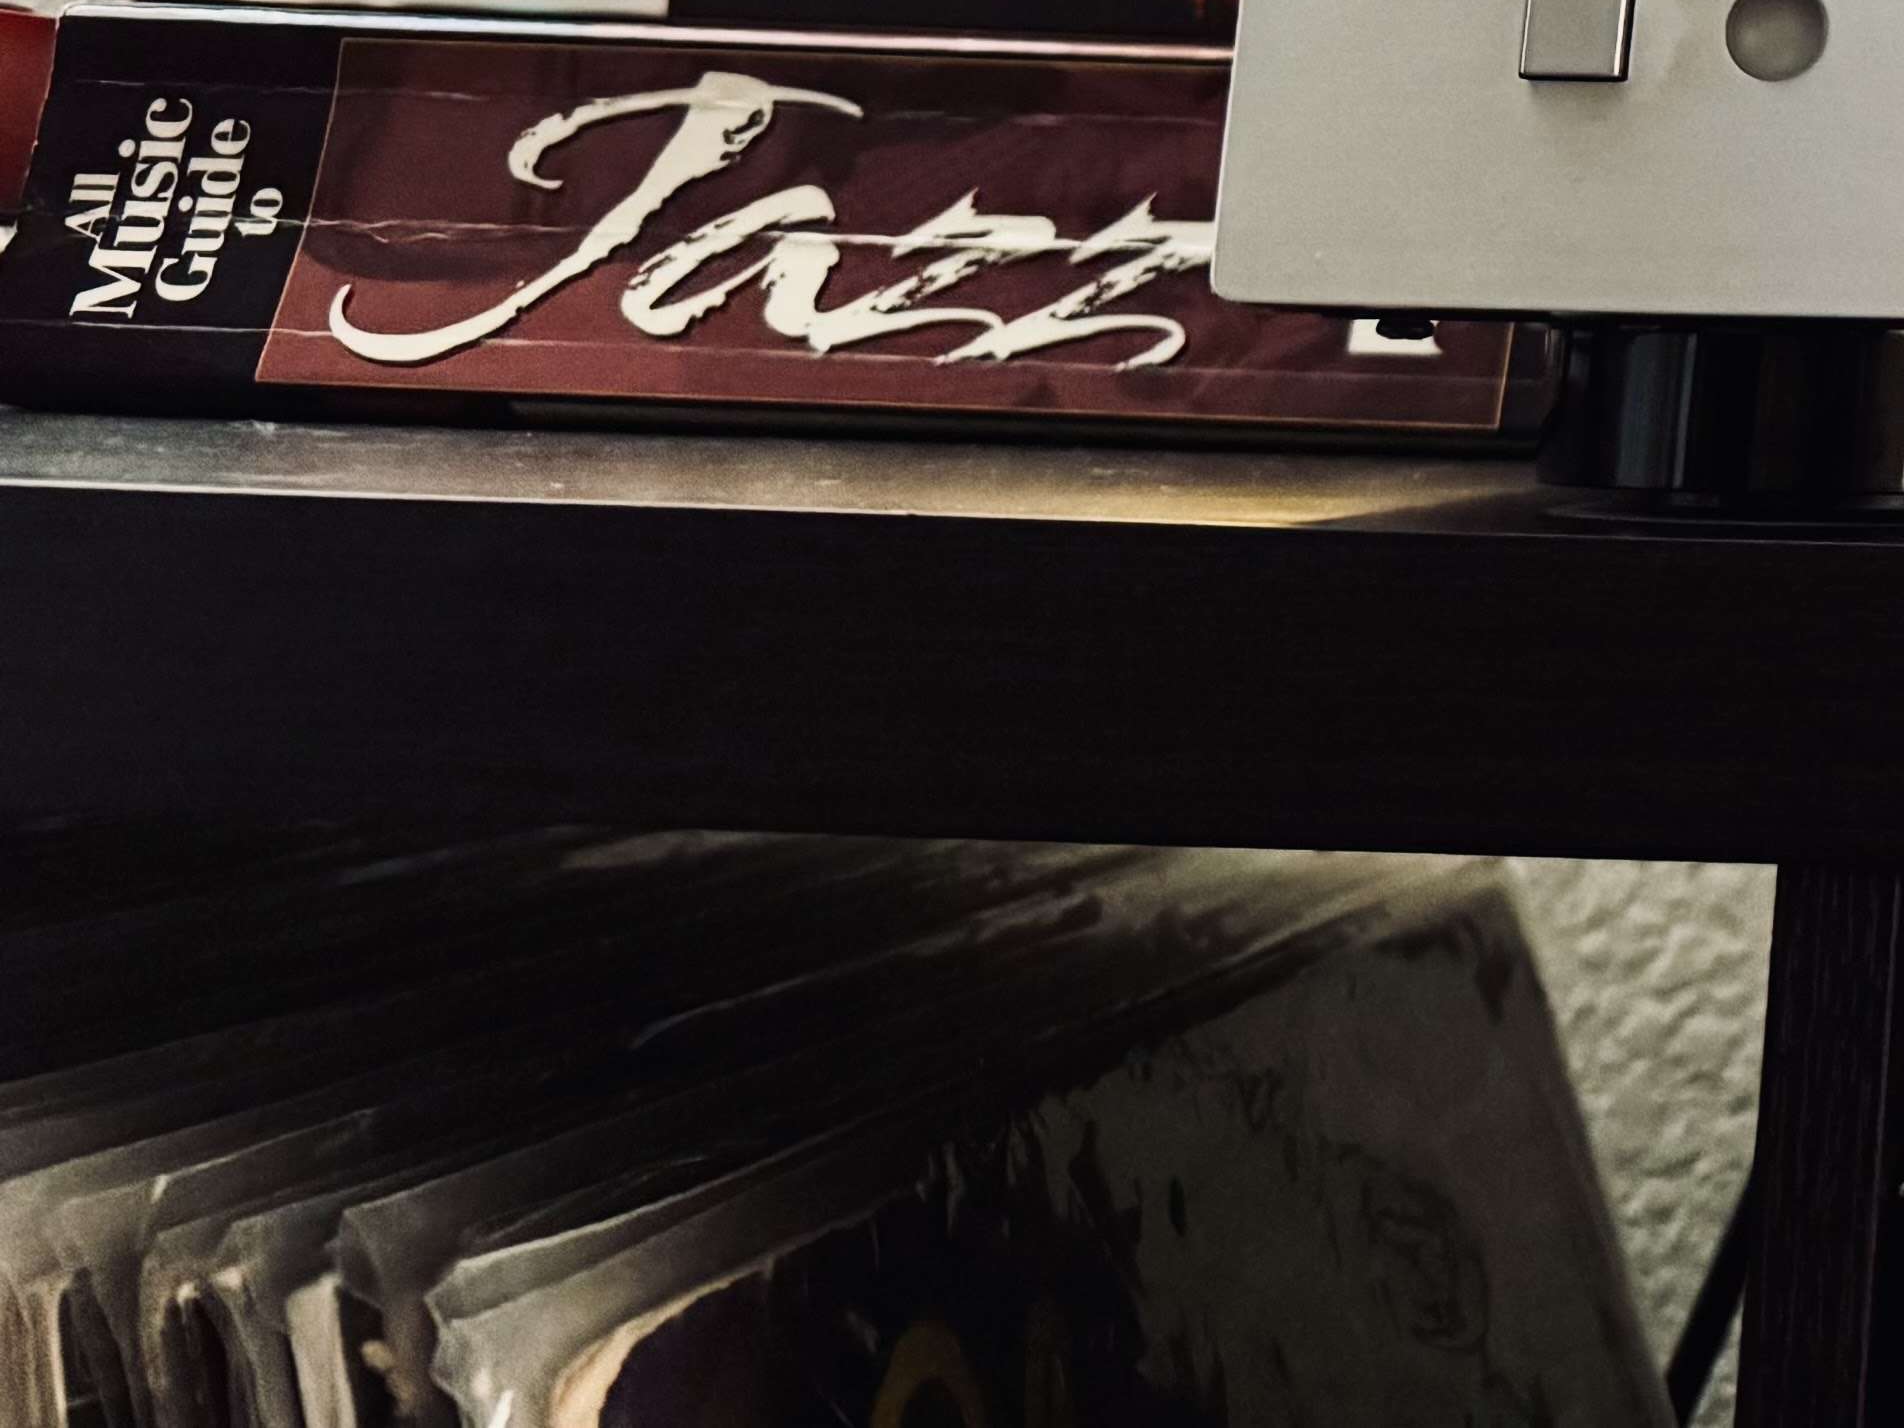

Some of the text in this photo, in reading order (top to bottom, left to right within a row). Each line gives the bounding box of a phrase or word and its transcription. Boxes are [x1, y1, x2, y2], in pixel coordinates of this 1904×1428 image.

[64, 172, 120, 240] All
[69, 98, 192, 319] Music
[155, 118, 251, 302] Guide
[232, 187, 283, 236] to
[329, 70, 1212, 372] Jazz
